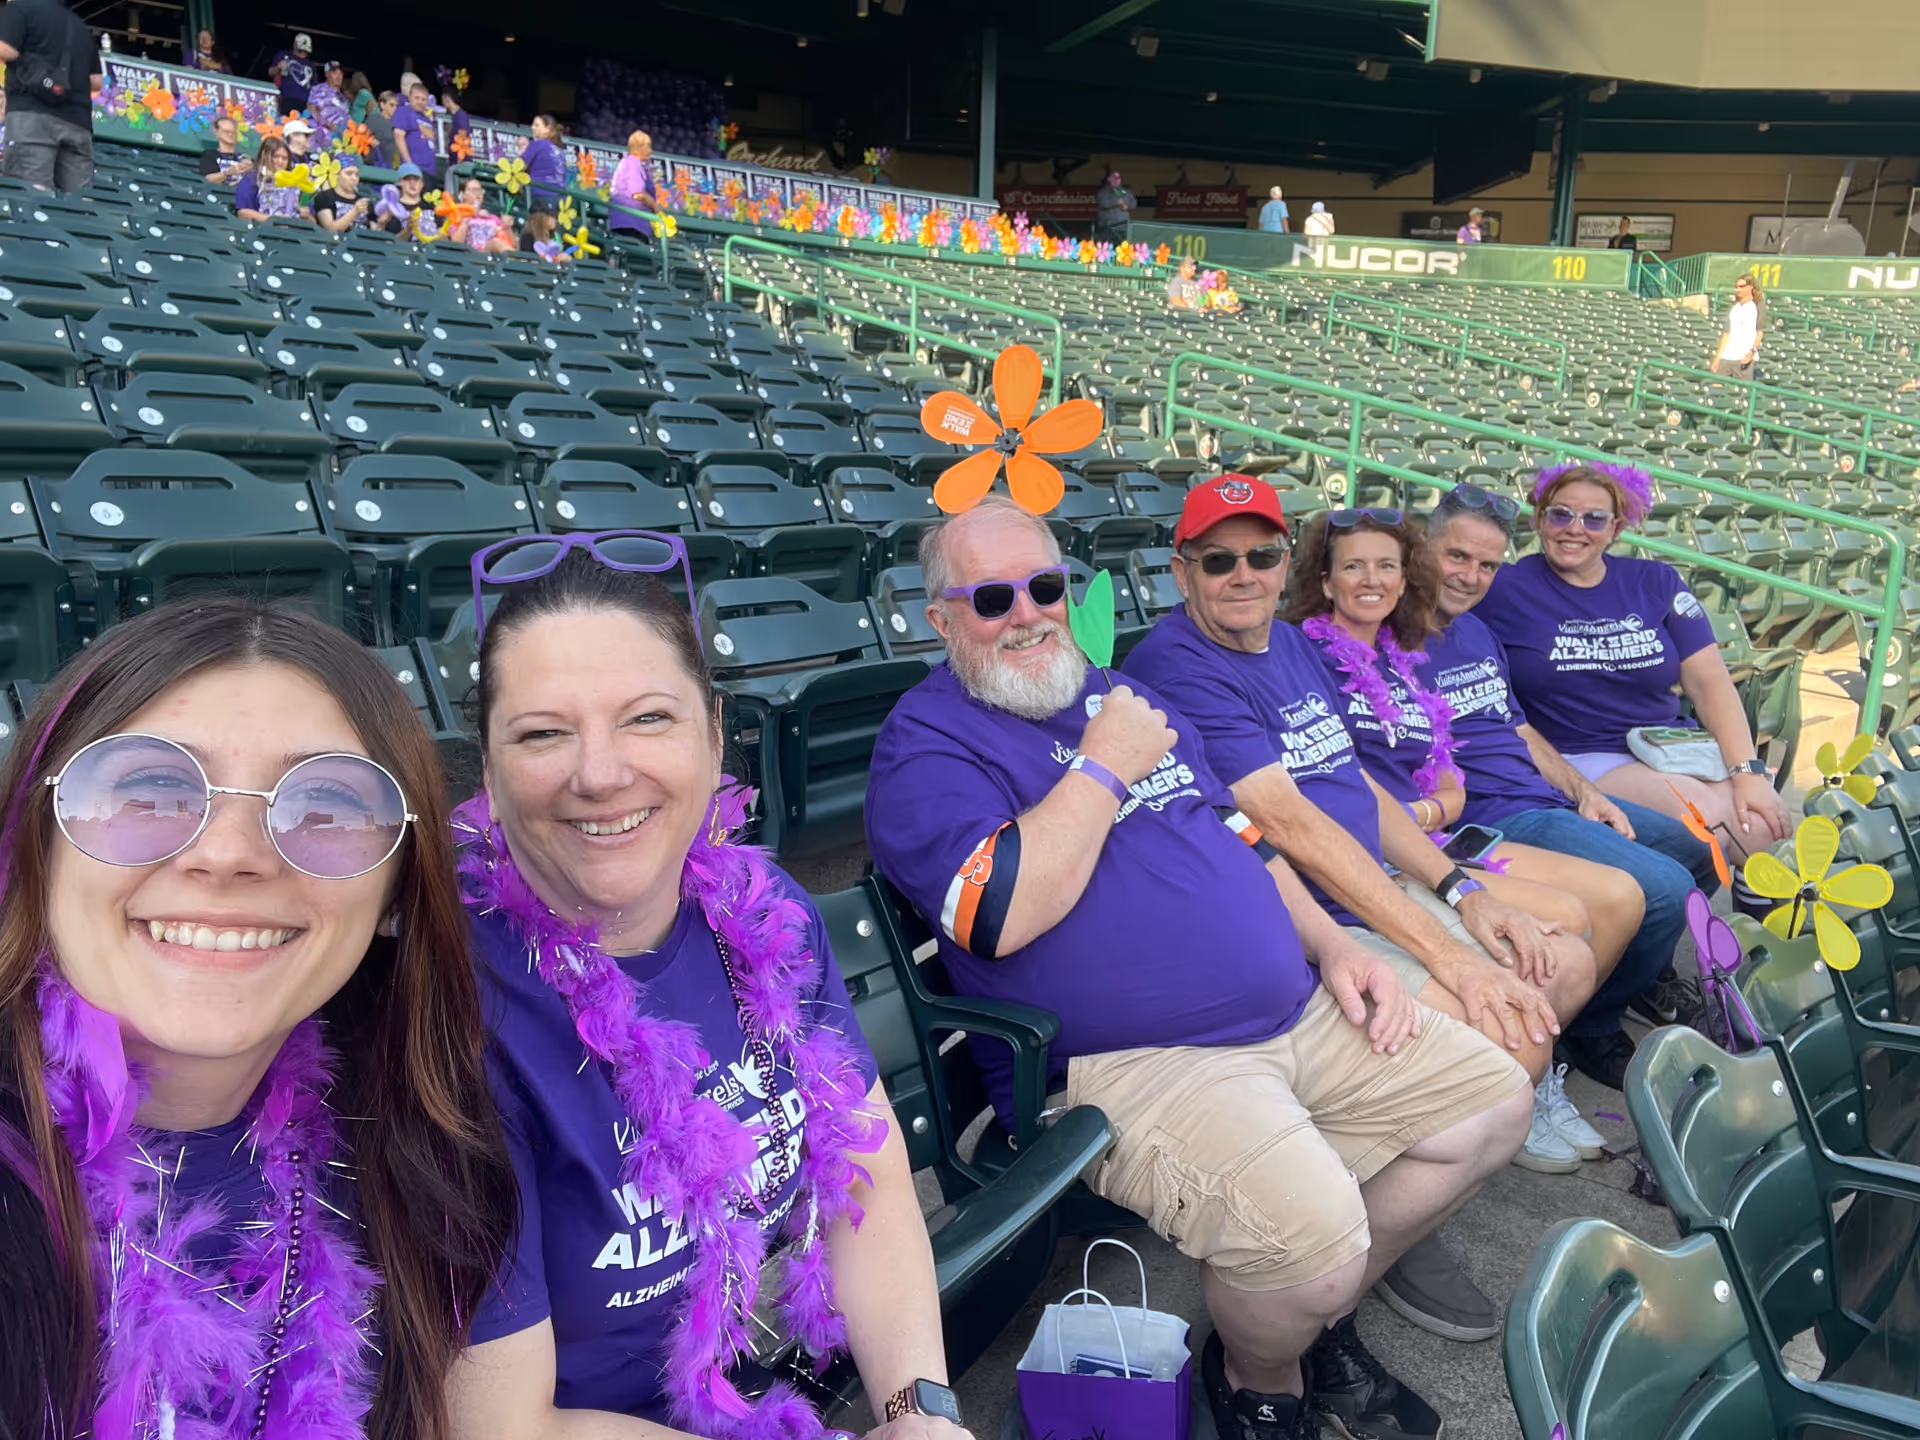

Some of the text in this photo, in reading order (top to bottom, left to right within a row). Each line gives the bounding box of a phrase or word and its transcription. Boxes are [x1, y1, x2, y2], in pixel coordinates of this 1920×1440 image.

[112, 65, 156, 81] WALK
[728, 142, 823, 170] Orchard
[1166, 192, 1238, 206] Fried Food
[1173, 234, 1206, 260] 110
[1291, 243, 1459, 275] NUCOR
[1552, 256, 1586, 280] 110
[1750, 263, 1781, 287] 111
[941, 421, 969, 437] WALK
[1554, 636, 1606, 648] WALK
[1621, 629, 1657, 647] END
[1550, 640, 1664, 661] ALZHEIMER'S
